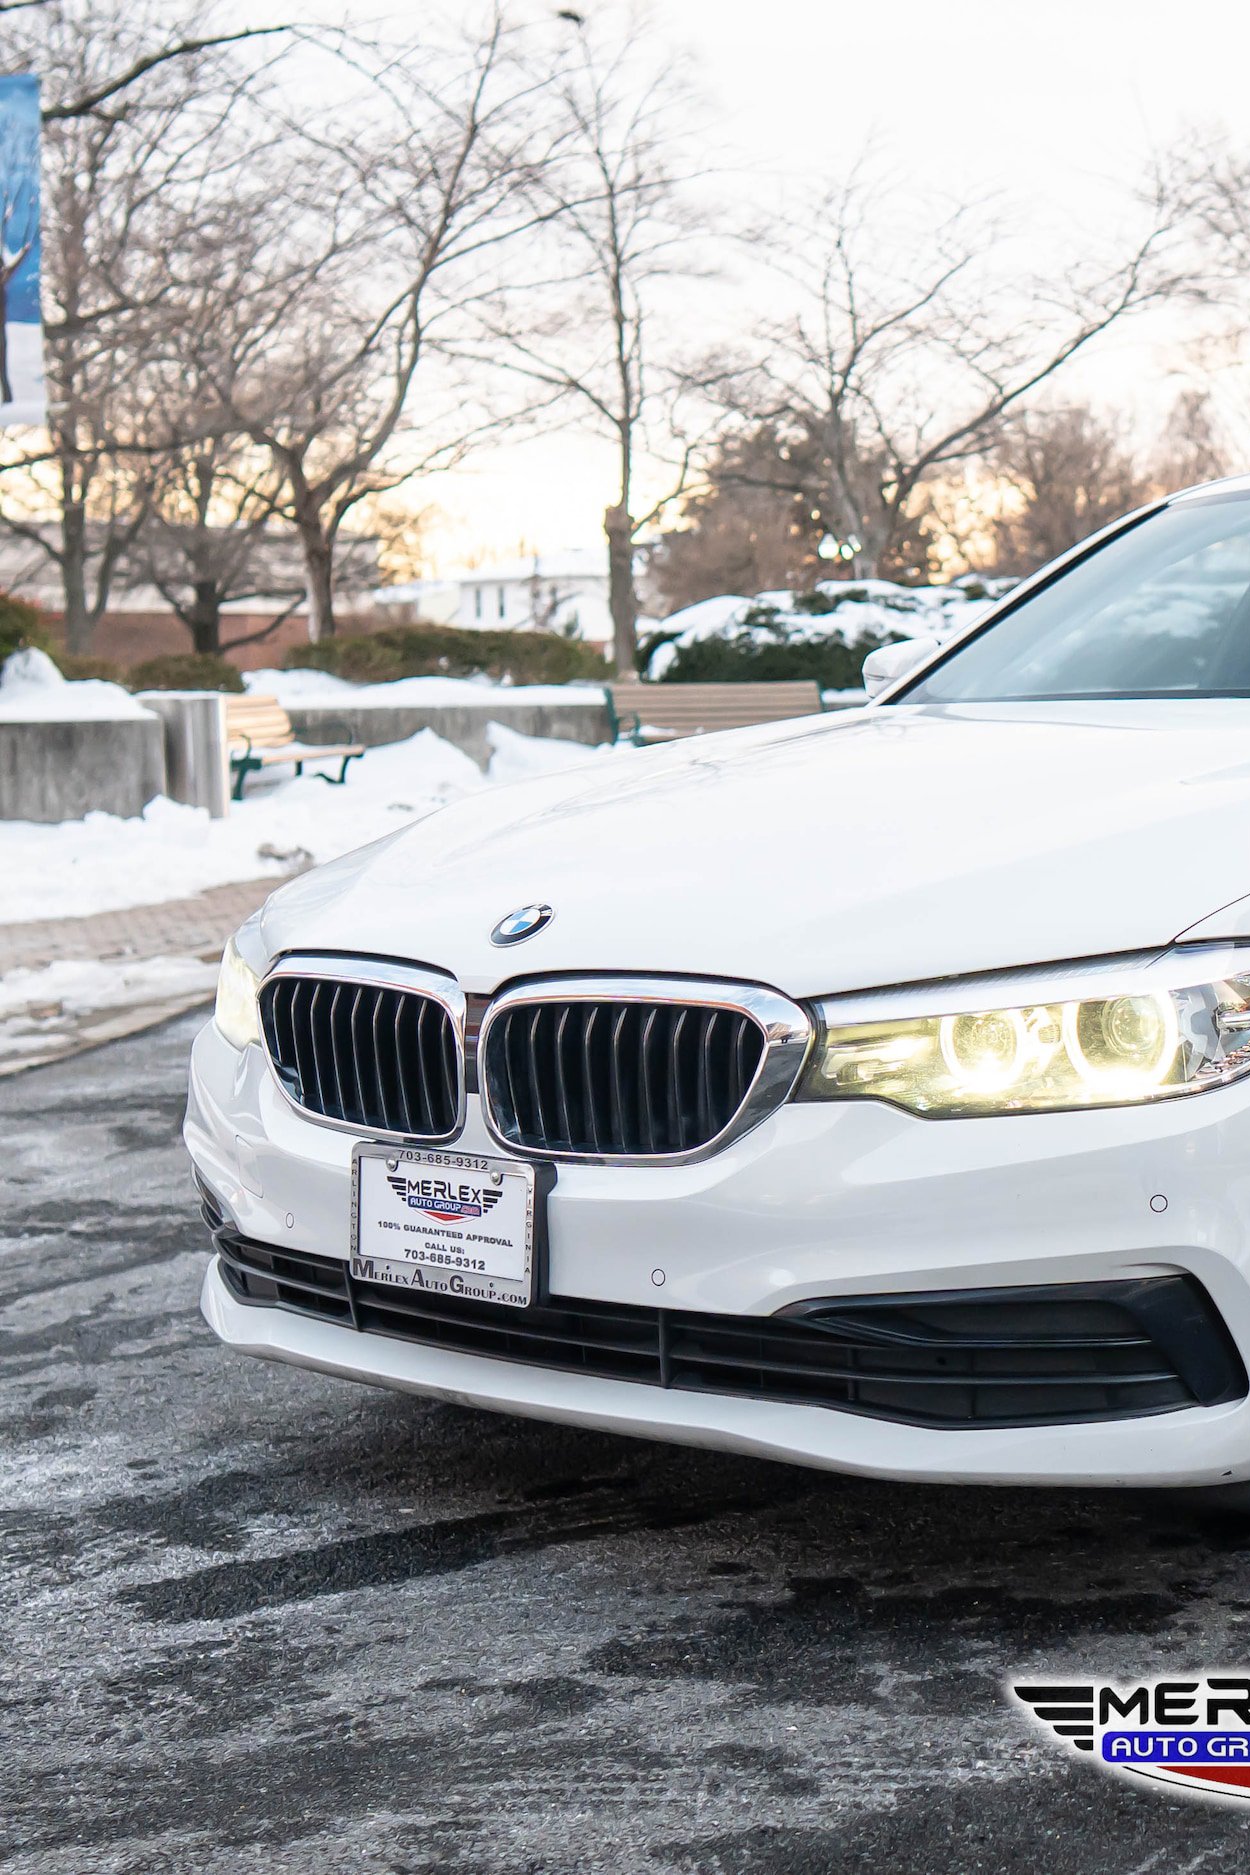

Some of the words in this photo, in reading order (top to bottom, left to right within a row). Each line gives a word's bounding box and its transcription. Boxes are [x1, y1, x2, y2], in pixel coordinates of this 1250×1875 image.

[398, 1149, 488, 1170] 703-685-9312
[407, 1179, 481, 1204] MERLEX
[410, 1197, 433, 1208] AUTO
[350, 1158, 358, 1251] ARLINGTON
[377, 1221, 401, 1231] 100%
[403, 1224, 463, 1240] GUARANTEED
[466, 1233, 514, 1248] APPROVAL
[524, 1184, 533, 1274] VIRGINIA
[404, 1248, 486, 1271] 703-685-9312
[424, 1242, 447, 1252] CALL
[450, 1245, 465, 1255] US:
